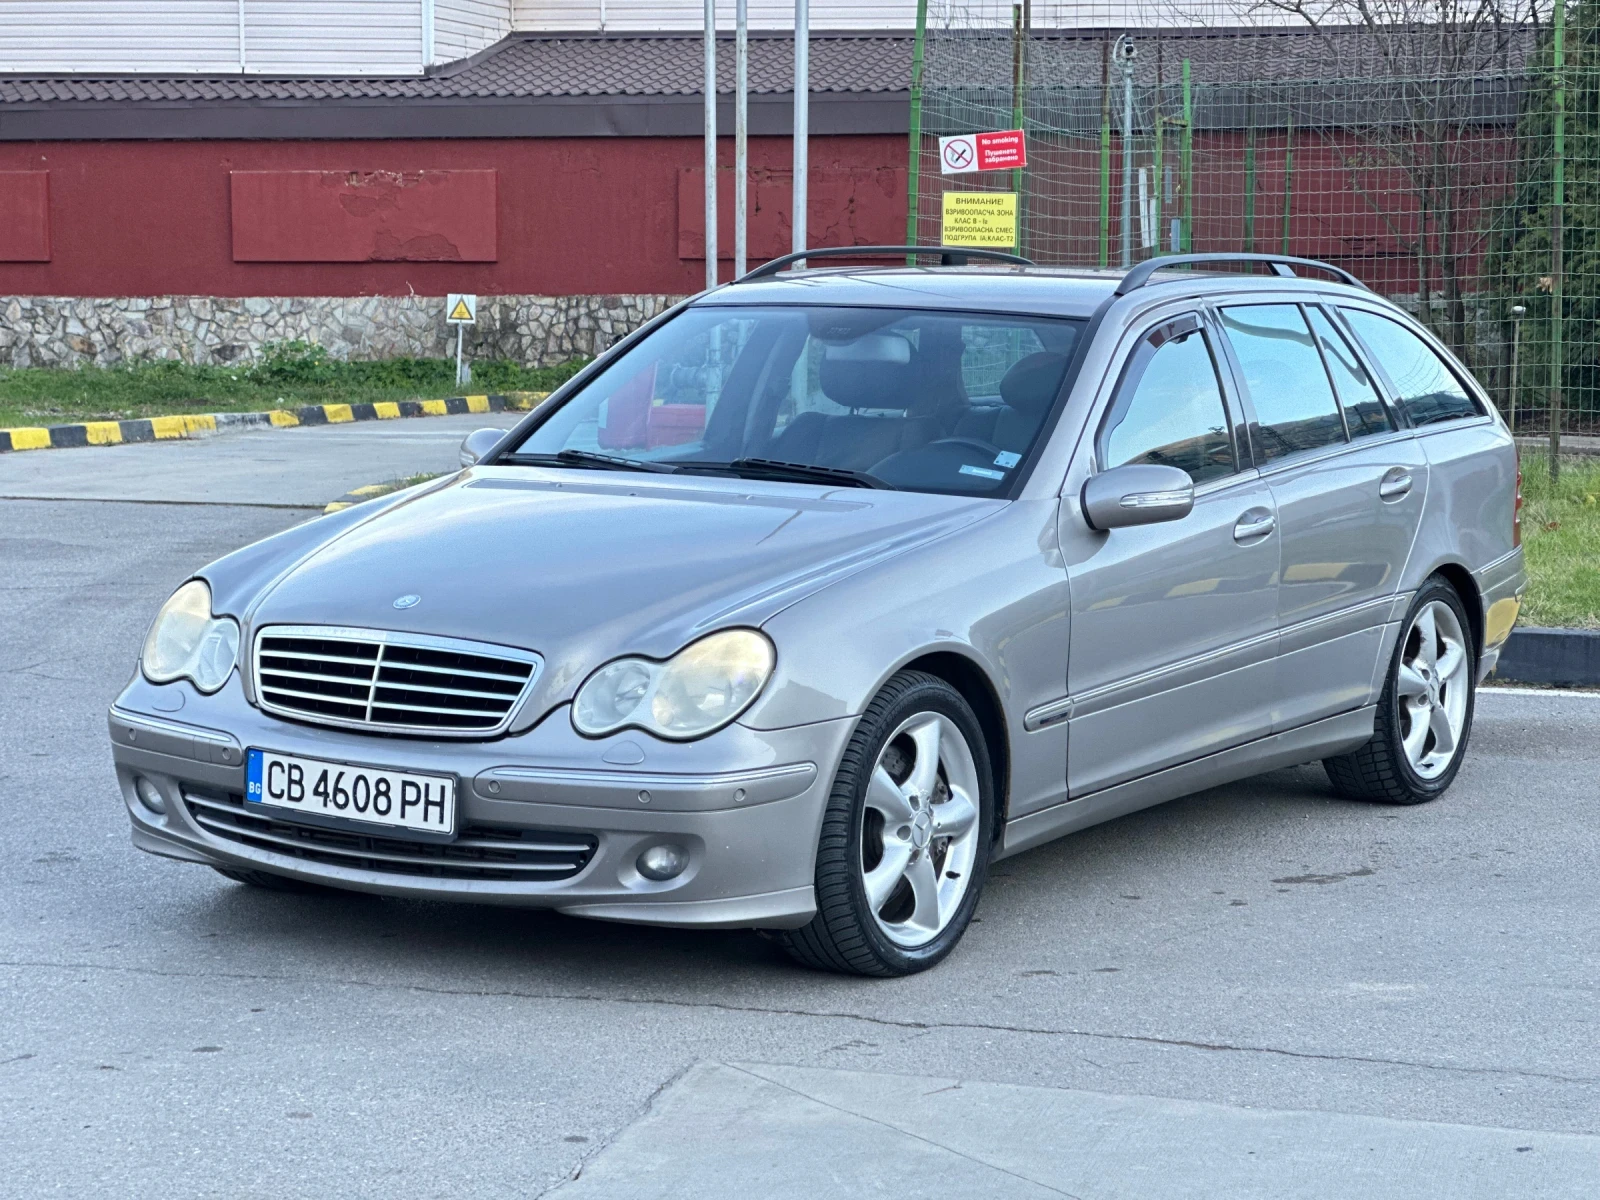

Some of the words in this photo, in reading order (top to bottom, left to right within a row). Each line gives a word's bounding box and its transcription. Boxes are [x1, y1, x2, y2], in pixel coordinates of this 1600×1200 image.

[992, 136, 1018, 145] smoking
[984, 149, 1017, 157] Пушенето
[985, 155, 1018, 164] забранено
[955, 197, 1004, 205] ВНИМАНИЕ!
[248, 781, 262, 795] BG
[267, 760, 305, 802] CB
[312, 768, 392, 816] 4608
[400, 779, 446, 824] PH
